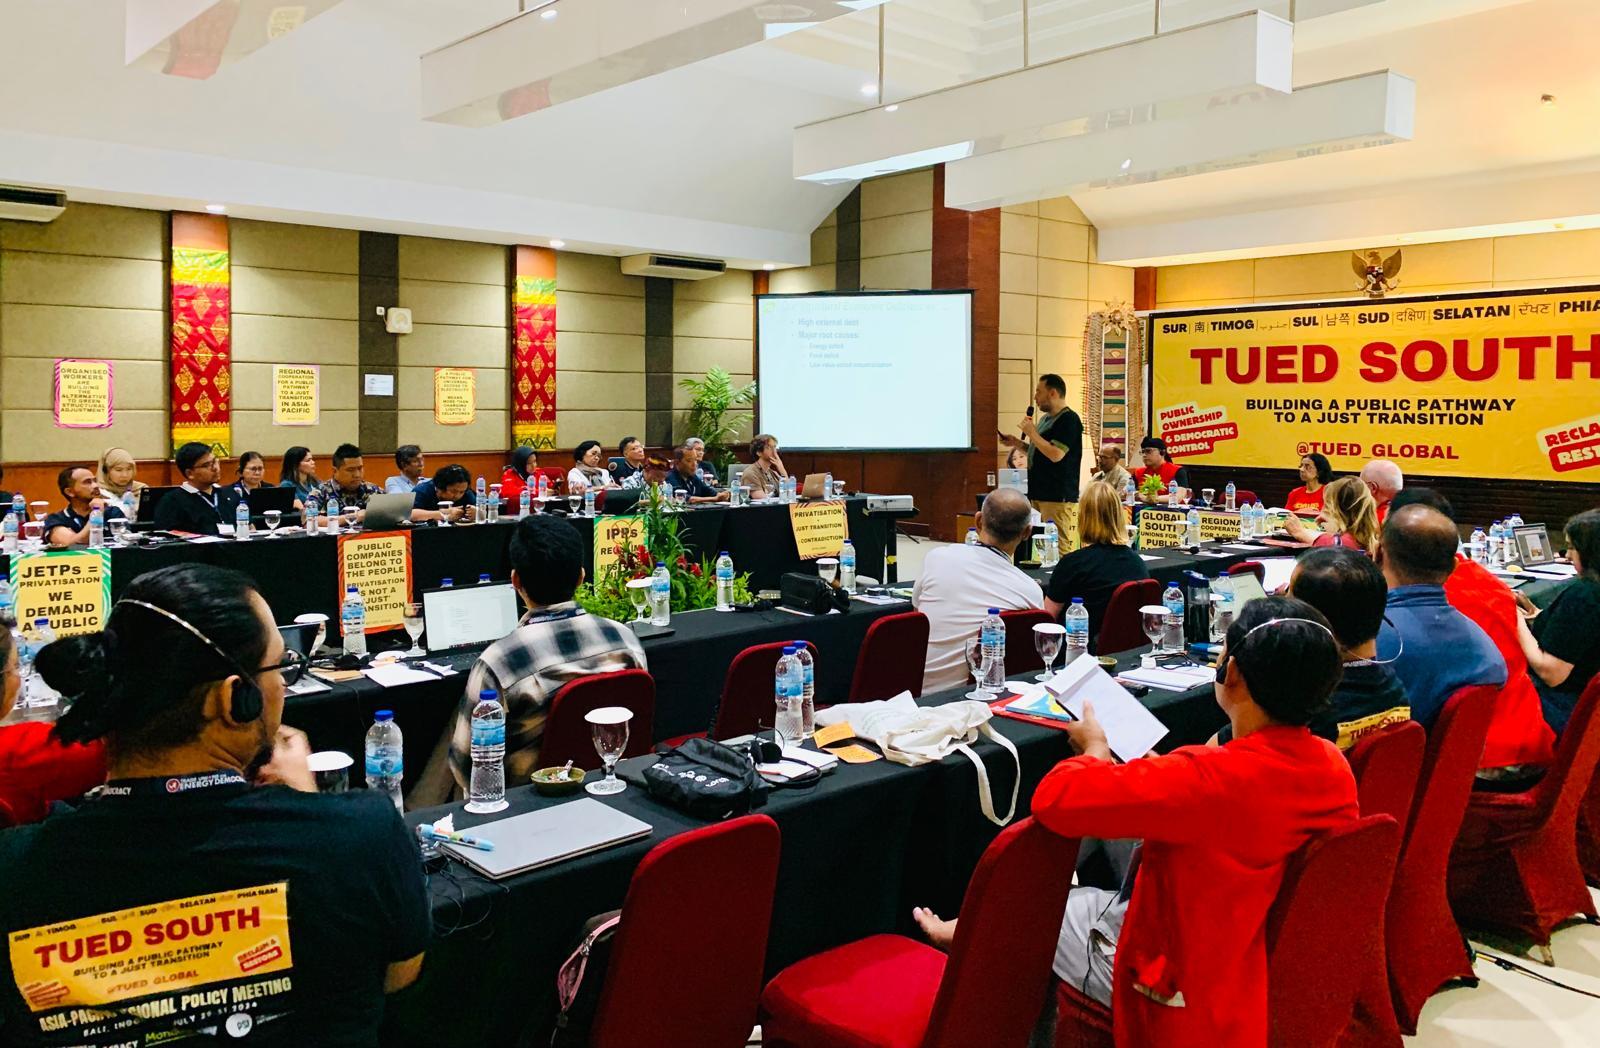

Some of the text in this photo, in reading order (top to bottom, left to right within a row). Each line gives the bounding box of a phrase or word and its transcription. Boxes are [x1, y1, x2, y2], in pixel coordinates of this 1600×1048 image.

[1163, 324, 1187, 333] SUR
[1195, 322, 1204, 332] 南
[1211, 320, 1254, 331] TIMOG
[1293, 316, 1319, 327] SUL
[1326, 314, 1350, 326] 남쪽
[1358, 312, 1389, 324] SUD
[1433, 305, 1510, 320] SELATAN
[1191, 334, 1600, 384] TUED SOUTH
[1246, 399, 1516, 411] BUILDING A PUBLIC PATHWAY
[1160, 406, 1194, 420] PUBLIC
[1274, 412, 1483, 425] TO A JUST TRANSITION
[1162, 411, 1222, 431] OWNERSHIP
[1174, 427, 1234, 442] DEMOCRATIC
[1167, 442, 1210, 454] CONTROL
[1297, 442, 1459, 459] @TUED_GLOBAL
[795, 509, 841, 518] PRIVATISATION
[1202, 517, 1240, 526] REGIONA
[357, 542, 392, 551] PUBLIC
[347, 550, 403, 560] COMPANIES
[22, 564, 81, 578] JETPs
[348, 560, 387, 569] BELONG
[346, 566, 404, 578] THE PEOPLE
[20, 576, 100, 588] PRIVATISATION
[48, 591, 73, 601] WE
[26, 604, 95, 618] DEMAND
[364, 602, 405, 612] NSITION
[22, 616, 98, 632] A UBLIC
[180, 779, 213, 791] ENERGY
[179, 898, 216, 909] SELATAN
[237, 890, 257, 899] PHIA
[34, 906, 260, 968] TUED SOUTH
[73, 941, 223, 977] BUILDING A PUBLIC PATHWAY
[93, 951, 209, 979] TO A JUST TRANSITION
[182, 988, 228, 1011] POLICY
[232, 977, 292, 1003] MEETING
